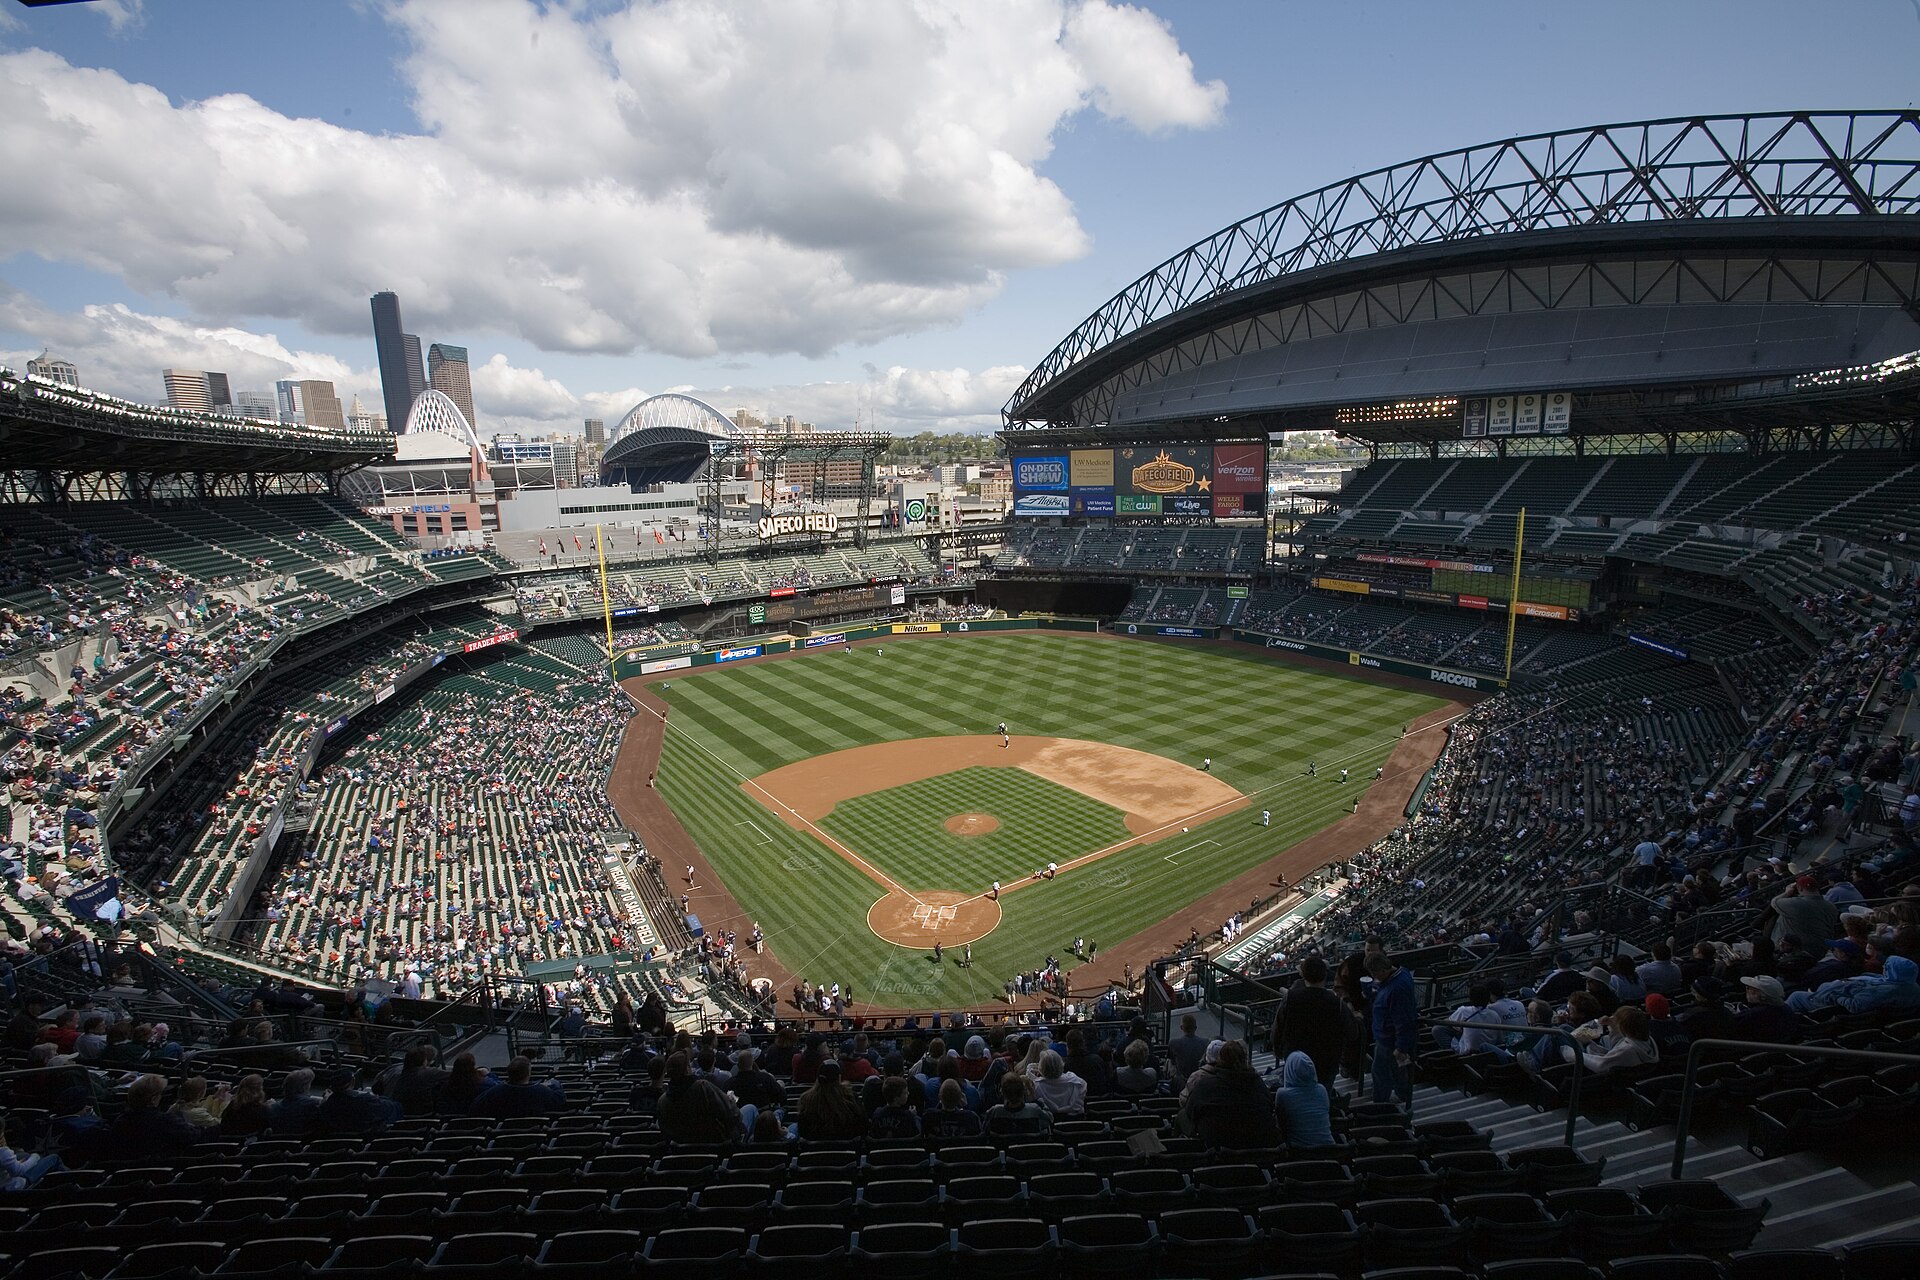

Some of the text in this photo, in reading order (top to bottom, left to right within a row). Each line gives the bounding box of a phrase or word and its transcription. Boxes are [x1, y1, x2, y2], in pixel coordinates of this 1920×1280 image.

[1134, 470, 1191, 483] SAFECO FIELD
[1218, 466, 1254, 475] verizon
[368, 504, 450, 514] QWEST FIELD
[759, 513, 838, 538] SAFECO FIELD
[839, 602, 859, 612] Seattle
[1526, 607, 1561, 618] Microsoft
[904, 624, 928, 633] Nikon
[468, 631, 515, 651] TRADER JOE'S
[1275, 640, 1305, 650] BOEING
[730, 648, 757, 658] PEPSI
[1360, 657, 1380, 667] WaMu
[1430, 670, 1477, 689] PACCAR
[75, 882, 108, 900] MARINERS
[609, 865, 631, 891] WELCOME
[622, 891, 635, 902] TO
[637, 924, 656, 945] FIELD
[1224, 914, 1304, 962] SEATTLE MARINERS
[871, 981, 937, 995] MARINERS
